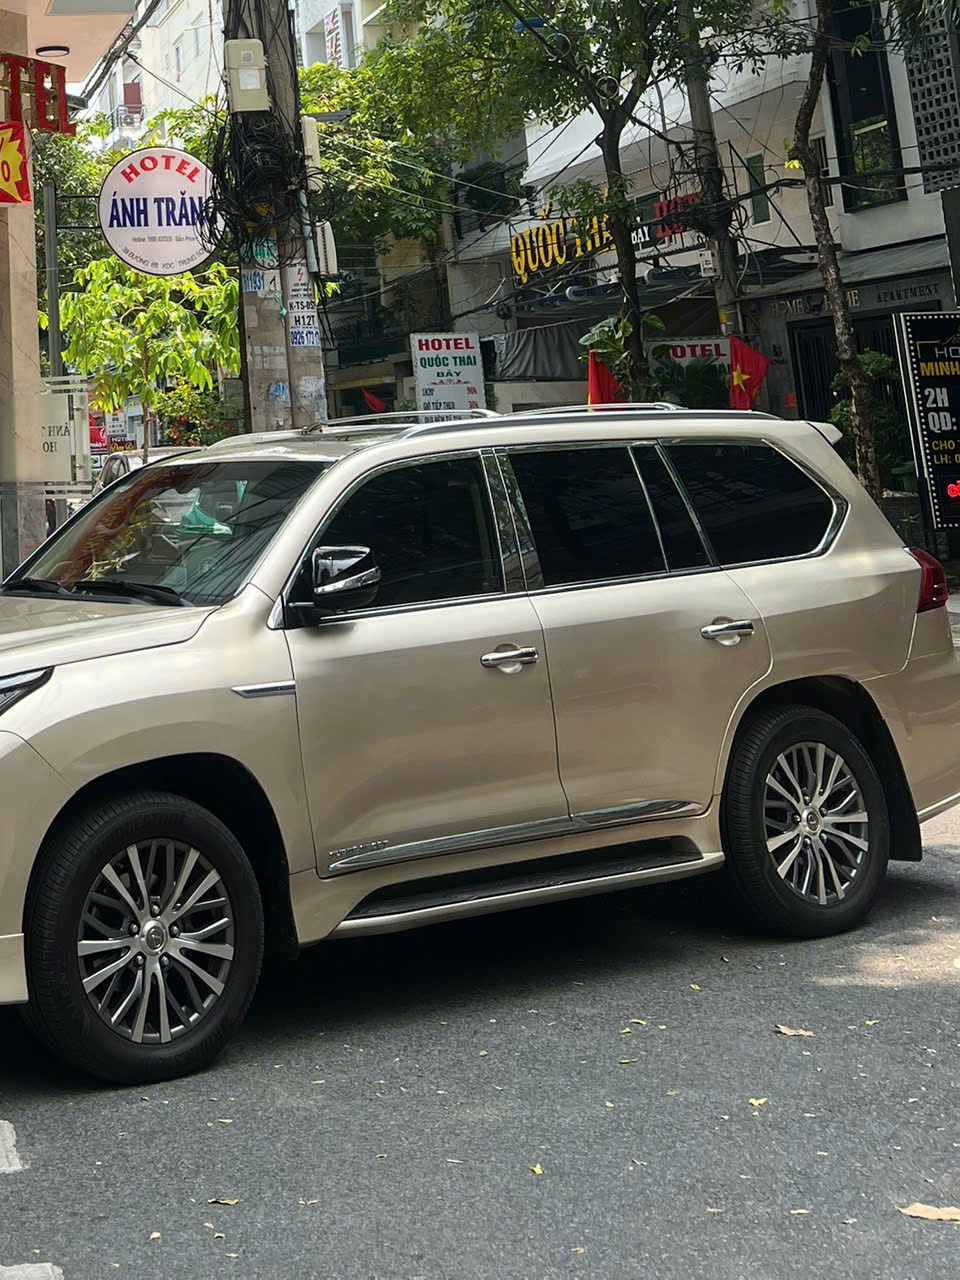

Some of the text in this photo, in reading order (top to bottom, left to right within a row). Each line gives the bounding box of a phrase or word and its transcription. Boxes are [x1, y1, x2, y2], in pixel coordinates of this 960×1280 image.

[120, 155, 200, 183] HOTEL
[109, 190, 204, 228] ÁNH TRĂN
[511, 201, 567, 284] QUỐC
[418, 337, 475, 351] HOTEL
[667, 344, 727, 359] OTEL
[420, 354, 477, 368] QUỐC THÁI
[924, 387, 950, 408] 2H
[927, 411, 957, 433] QD:
[932, 440, 955, 450] CHO
